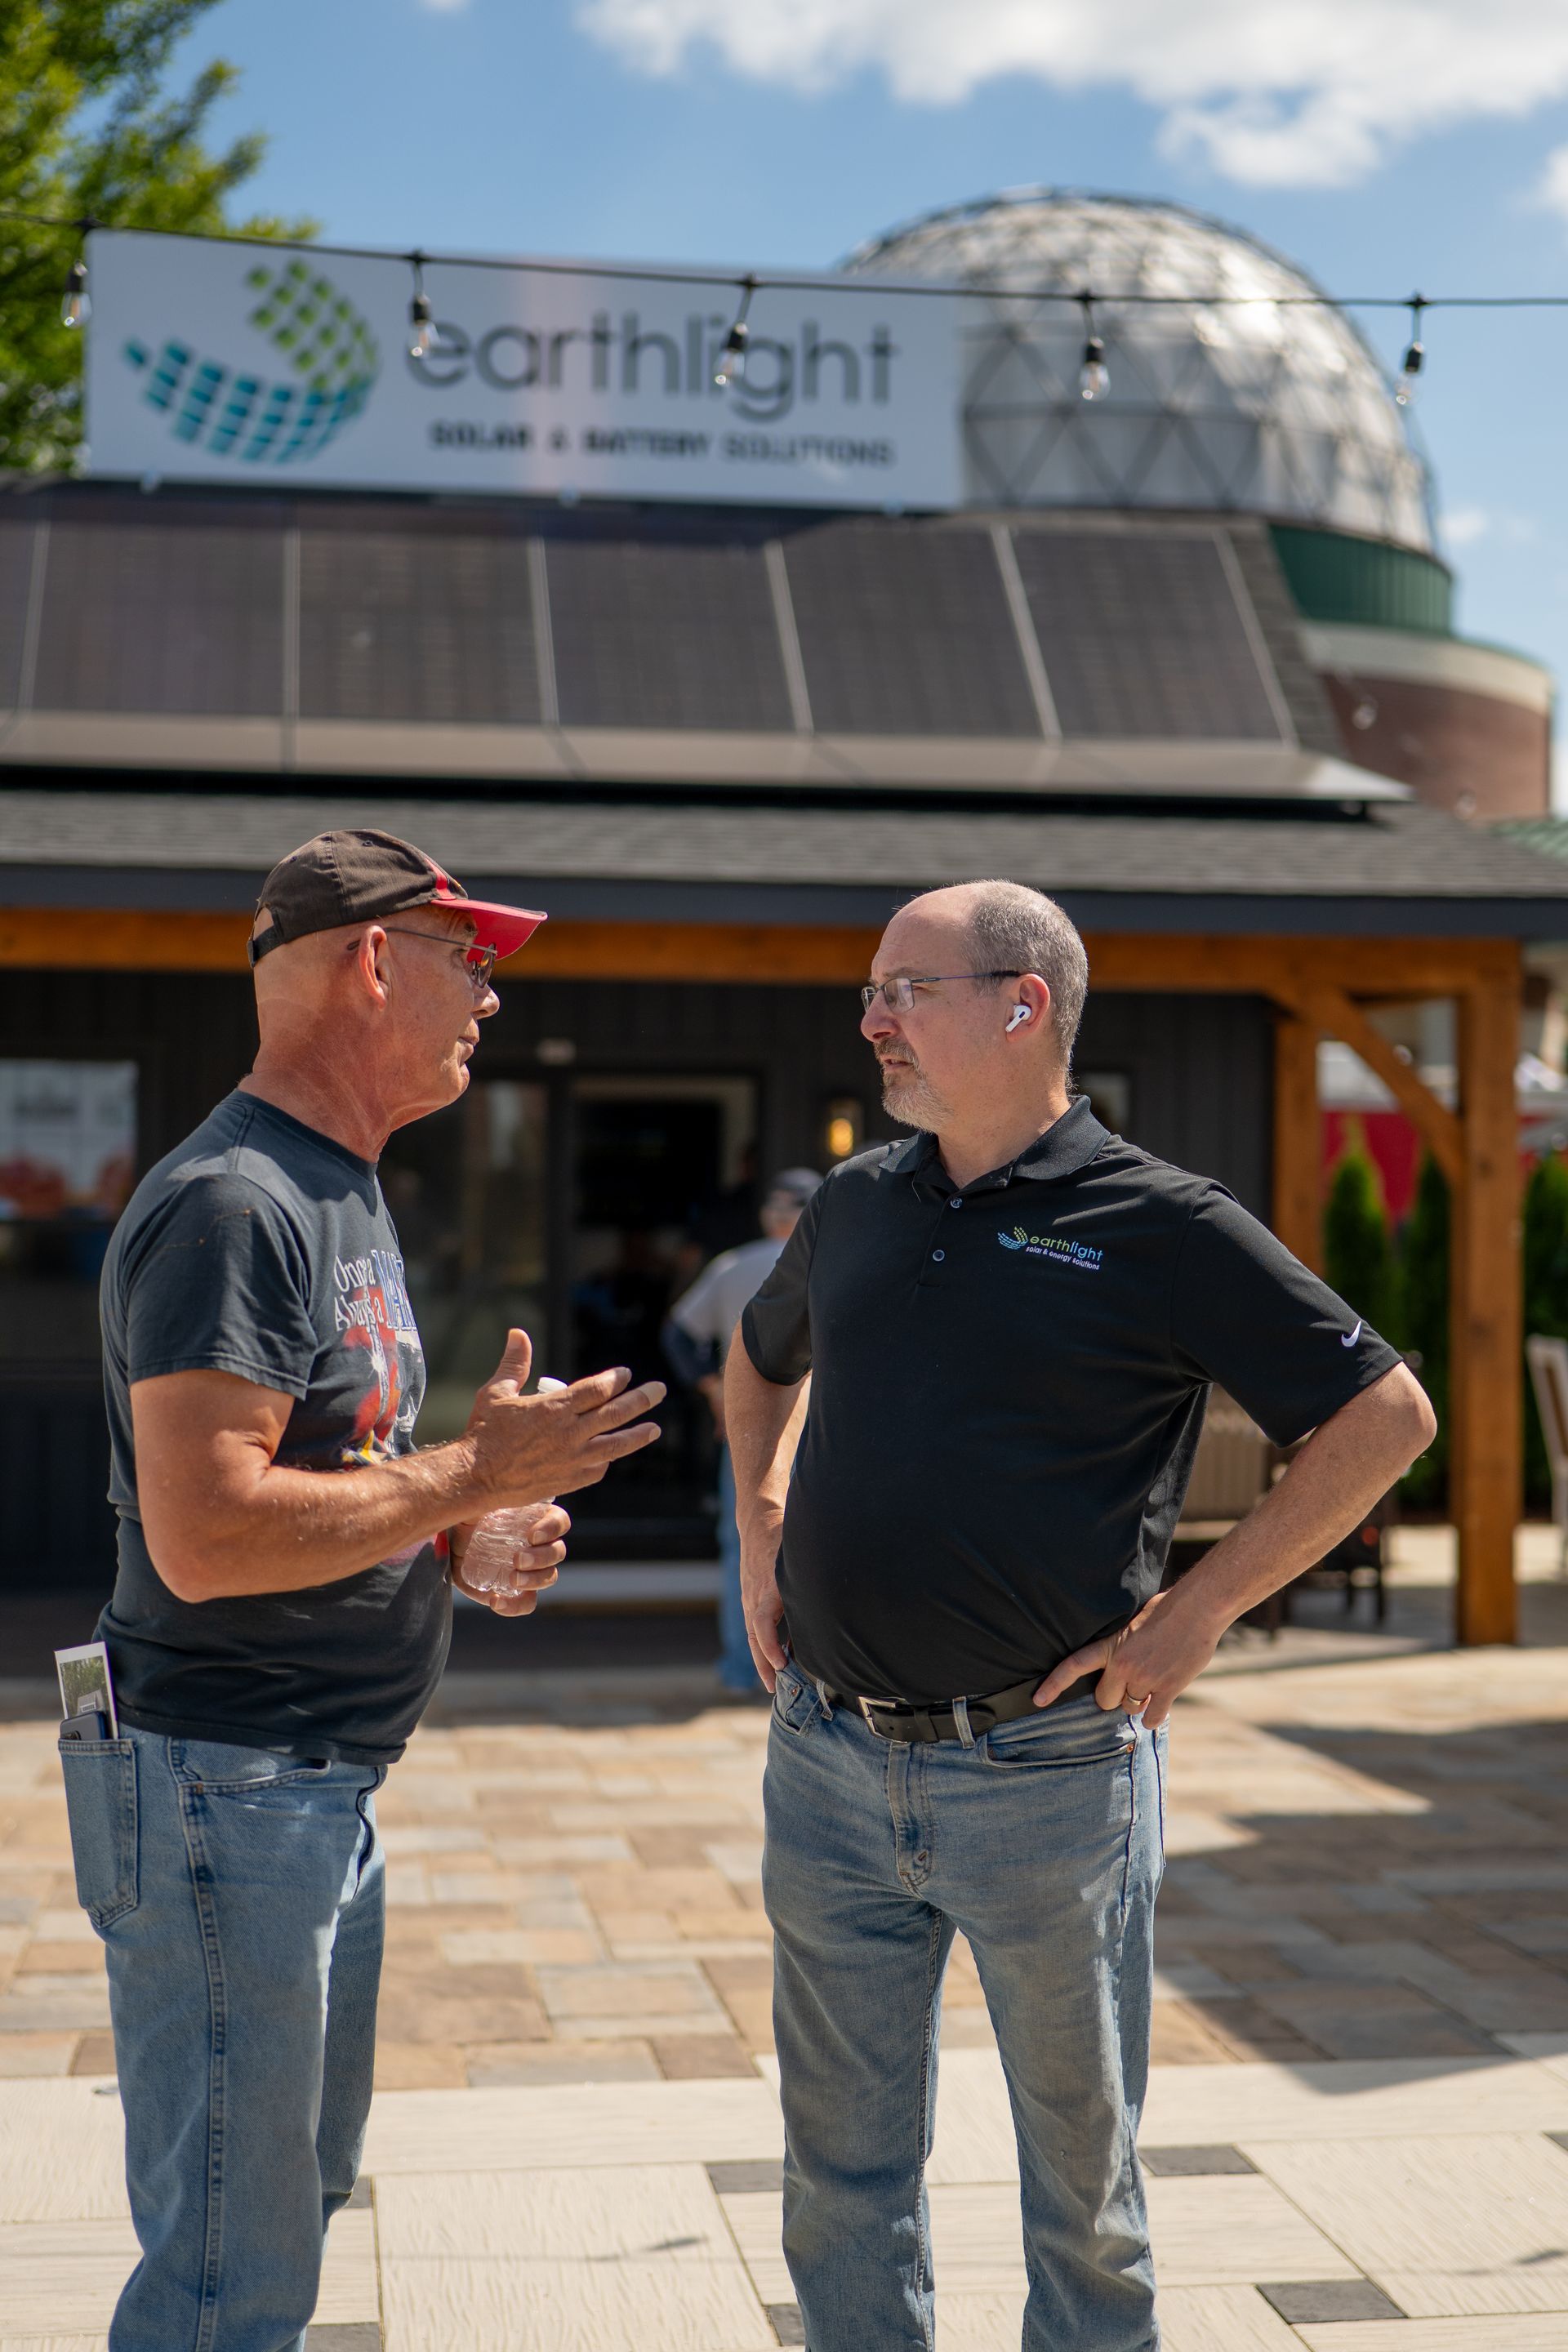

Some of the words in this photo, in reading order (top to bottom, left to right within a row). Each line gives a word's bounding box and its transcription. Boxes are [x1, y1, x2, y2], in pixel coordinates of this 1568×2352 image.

[406, 310, 898, 423] earthlight
[431, 420, 534, 450] SOLAR
[583, 426, 709, 459] BATTERY
[725, 434, 894, 467] SOLUTIONS
[1026, 1245, 1042, 1254] solar
[1049, 1250, 1071, 1263] energy
[1072, 1257, 1100, 1270] solutions
[1030, 1236, 1103, 1261] earthlight
[334, 1295, 376, 1333] Always
[374, 1296, 384, 1324] a
